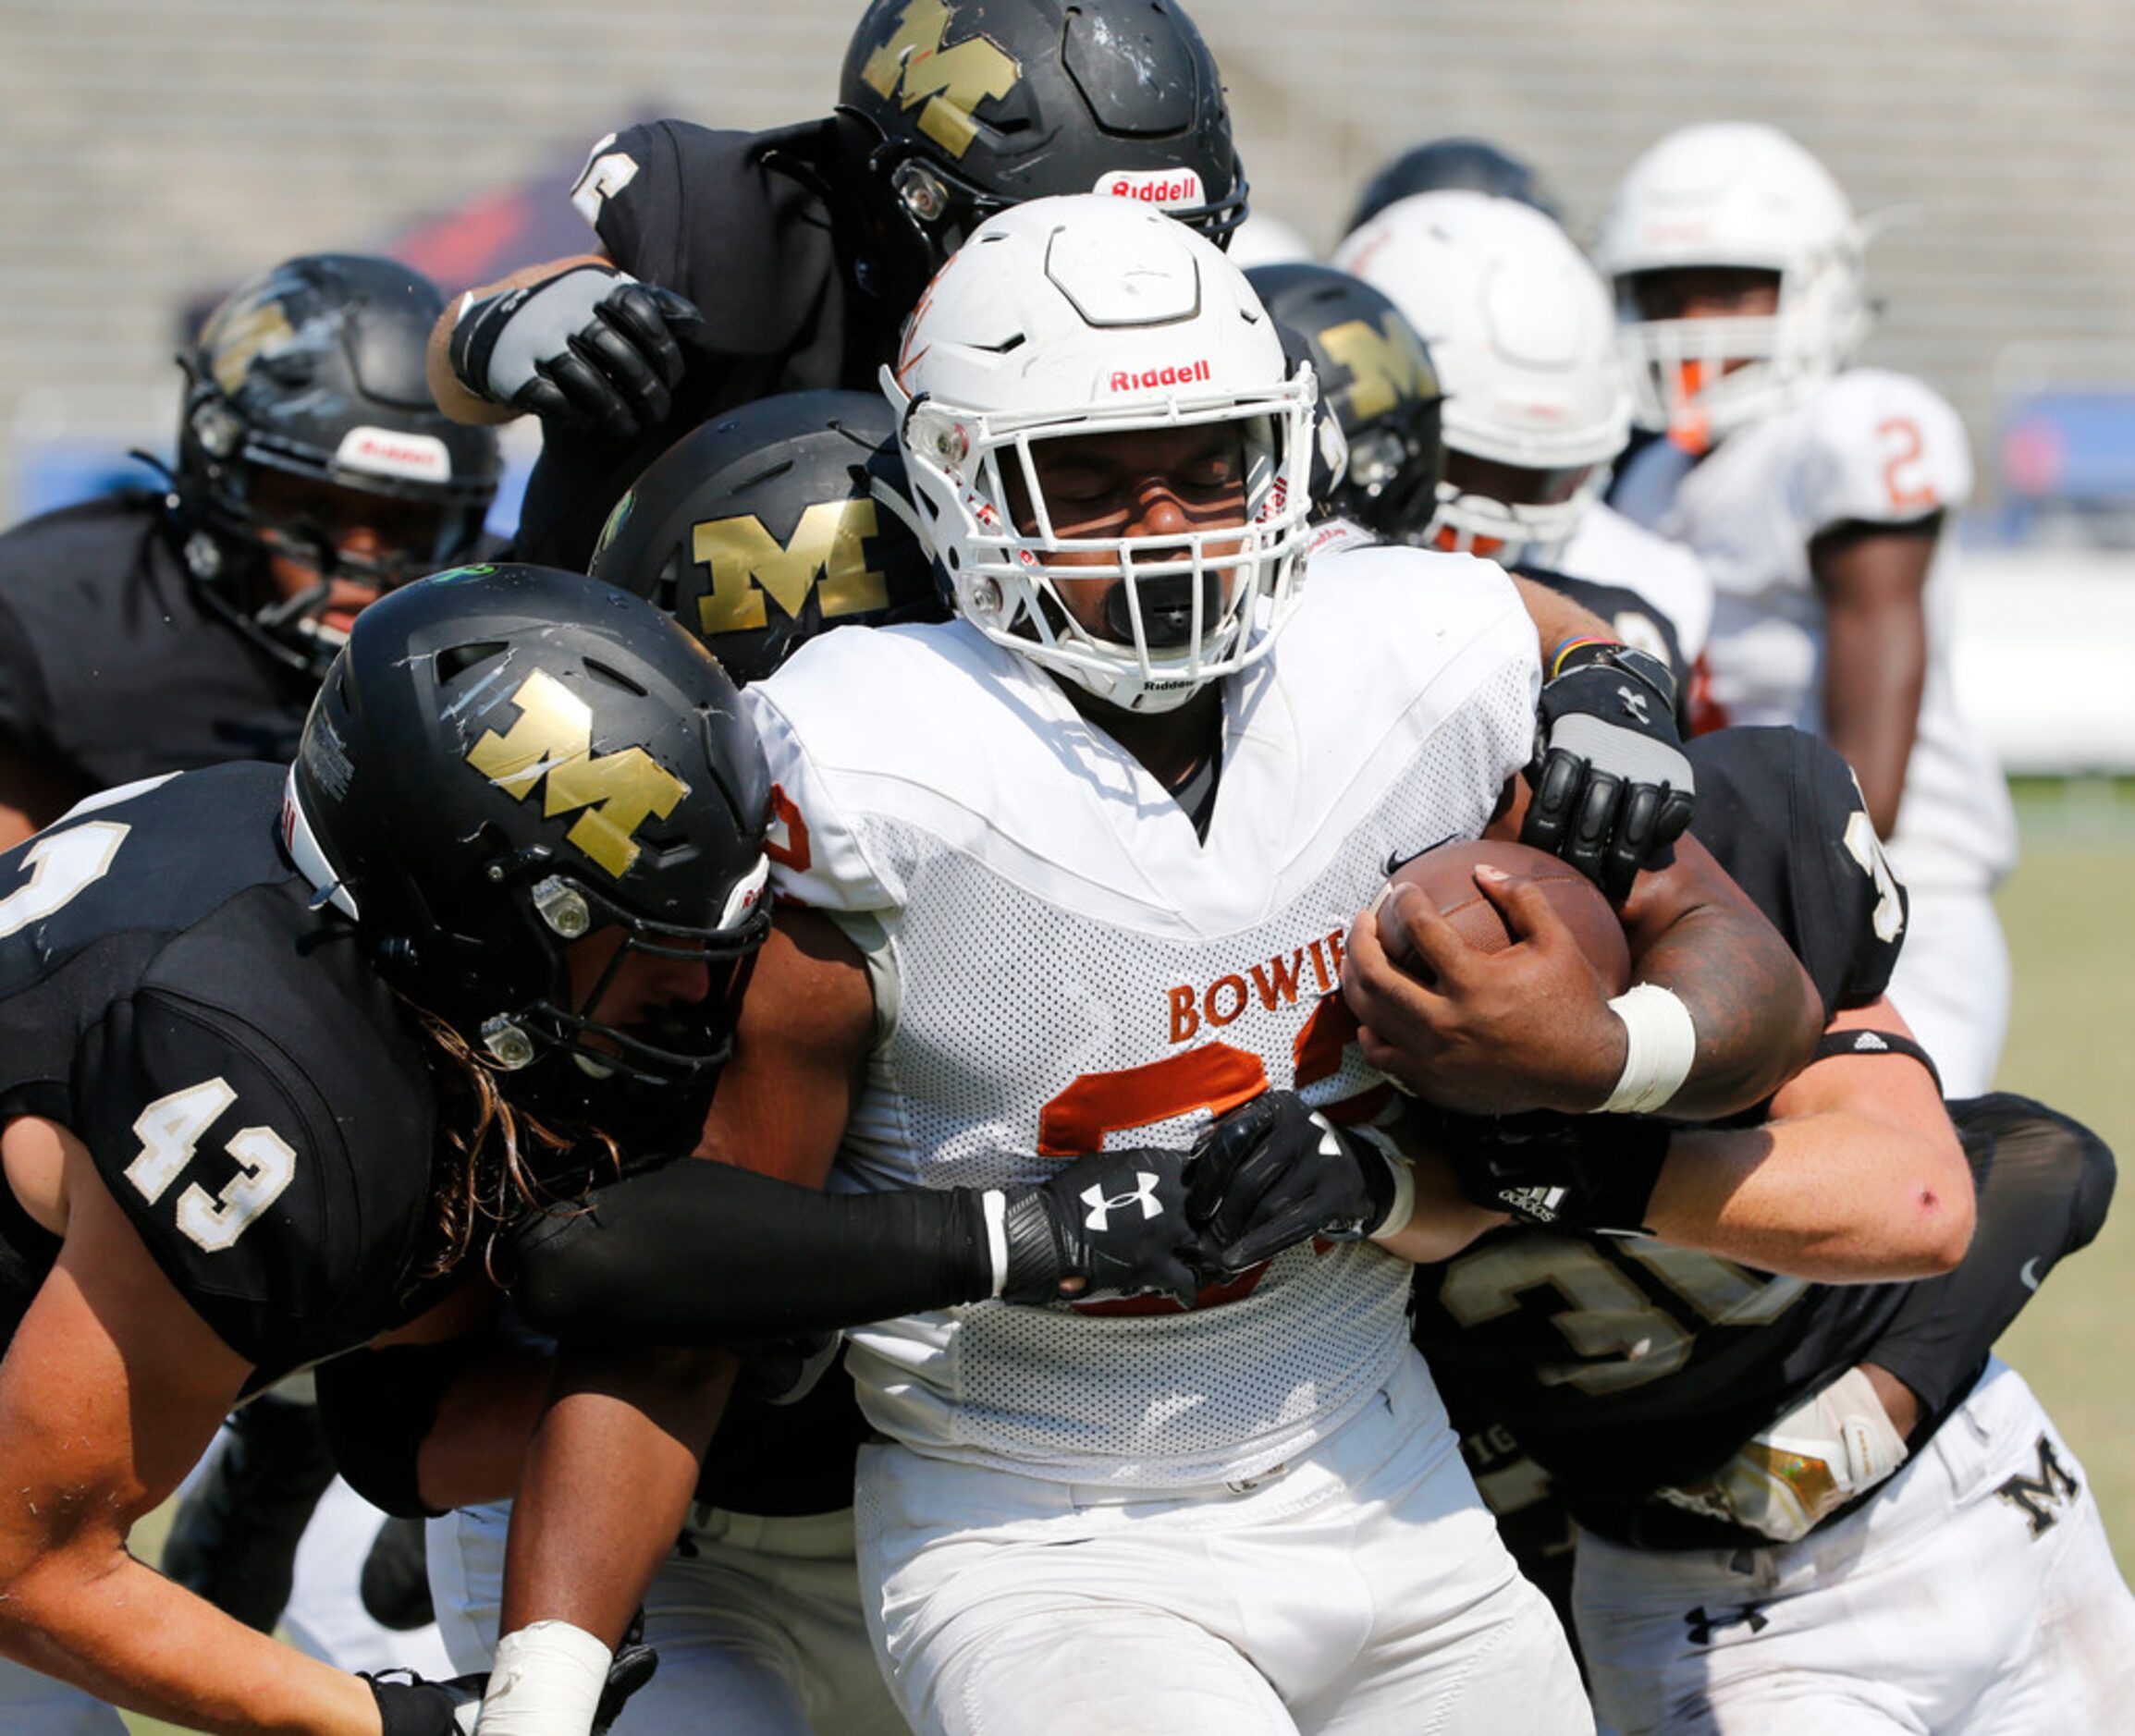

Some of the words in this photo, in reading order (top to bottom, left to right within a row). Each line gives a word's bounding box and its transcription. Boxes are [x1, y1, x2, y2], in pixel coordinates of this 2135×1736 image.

[862, 0, 1021, 159] M
[1112, 177, 1195, 202] Riddell
[1110, 360, 1209, 392] Riddell
[1318, 311, 1440, 420] M
[1875, 417, 1938, 512] 2
[693, 497, 890, 634] M
[465, 666, 690, 878] M
[122, 1076, 297, 1253] 43
[1499, 1190, 1555, 1222] adidas
[1993, 1432, 2080, 1542] M
